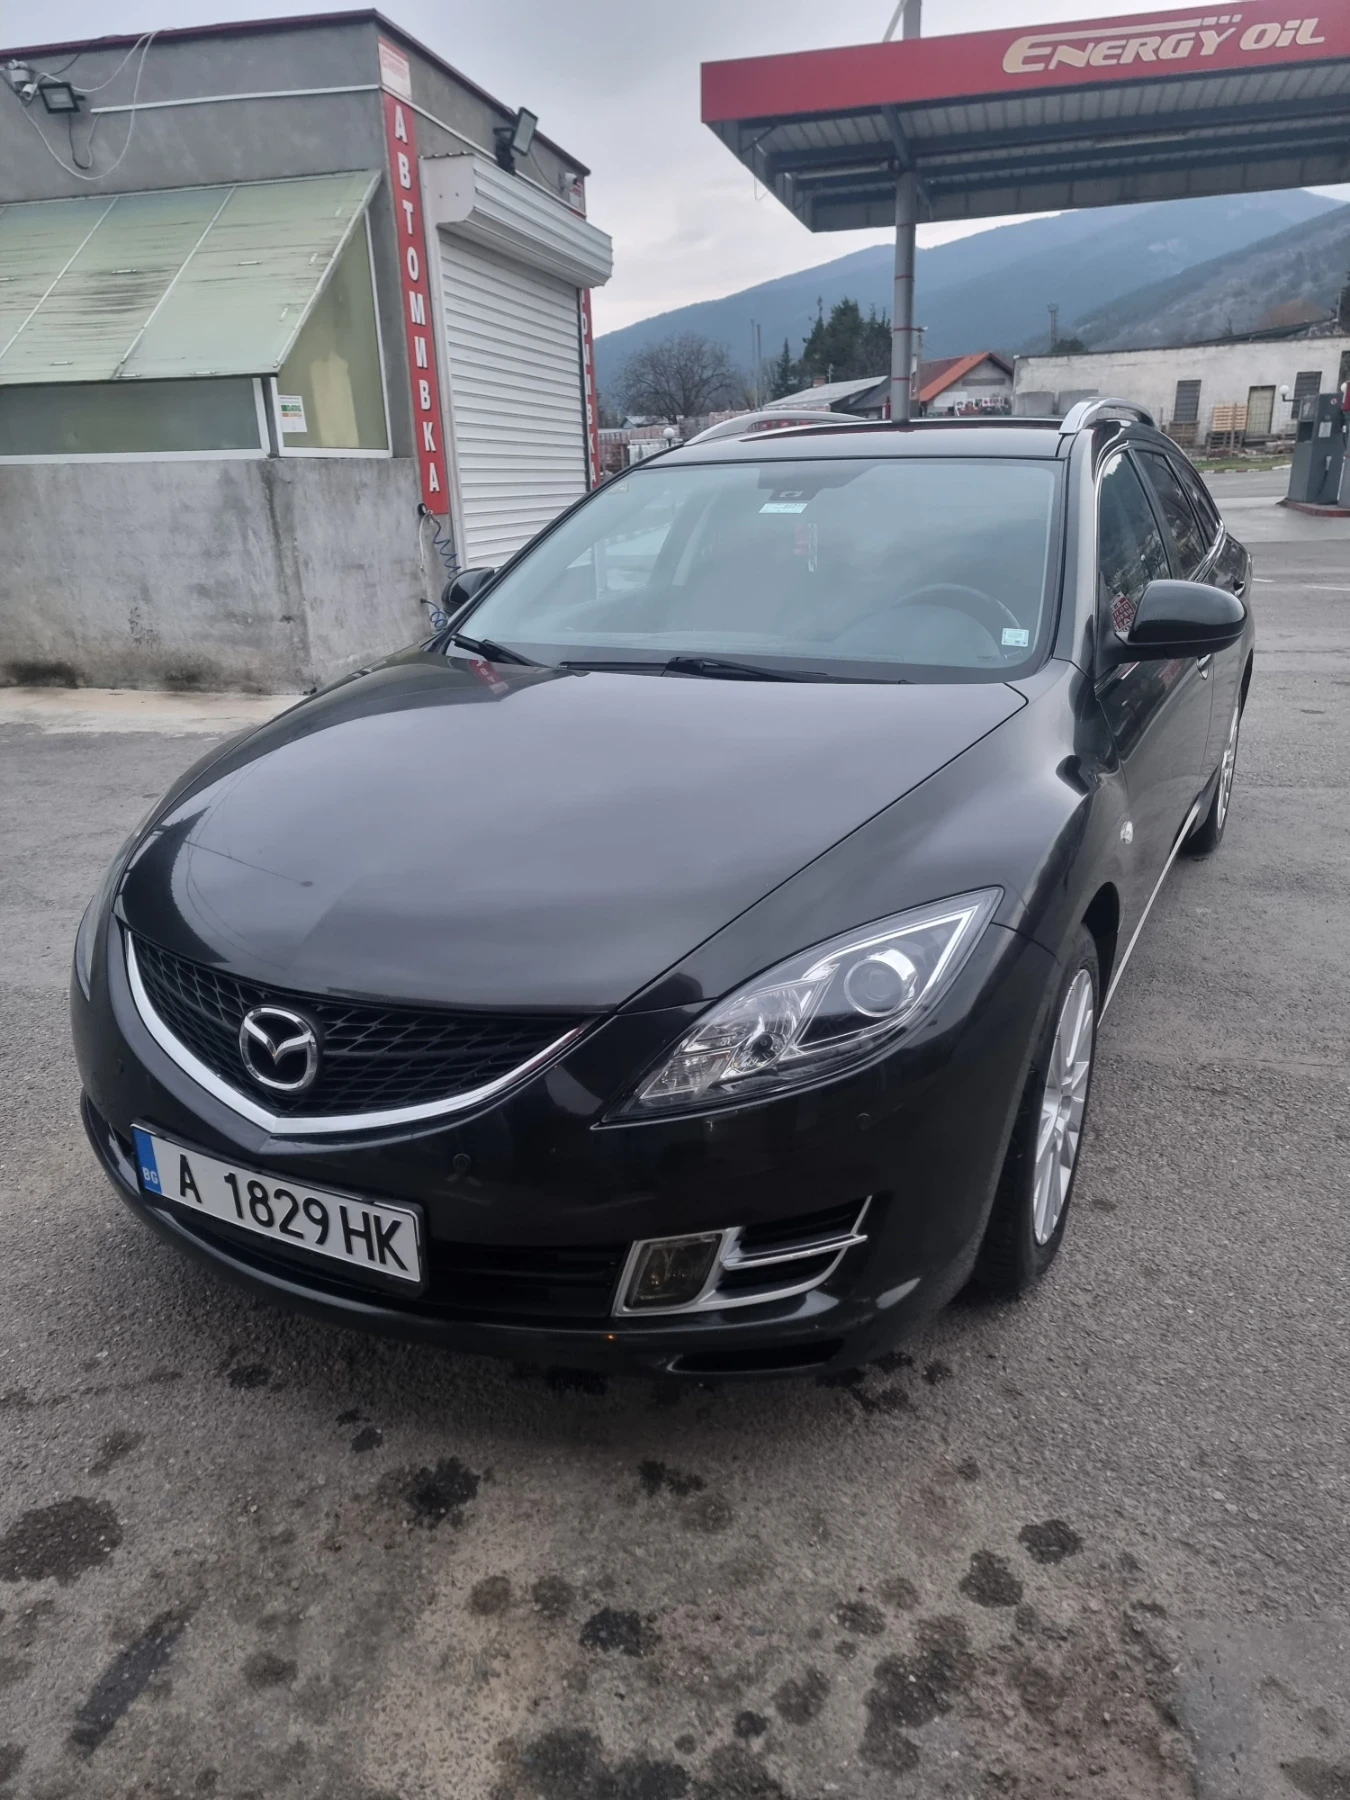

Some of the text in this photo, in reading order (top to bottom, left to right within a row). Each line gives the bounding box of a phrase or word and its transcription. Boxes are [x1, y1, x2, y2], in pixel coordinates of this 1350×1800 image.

[1002, 14, 1242, 74] ENERGY
[394, 104, 440, 493] АВТОМИВКА
[142, 1166, 159, 1185] BG
[179, 1153, 410, 1272] A 1829 HK
